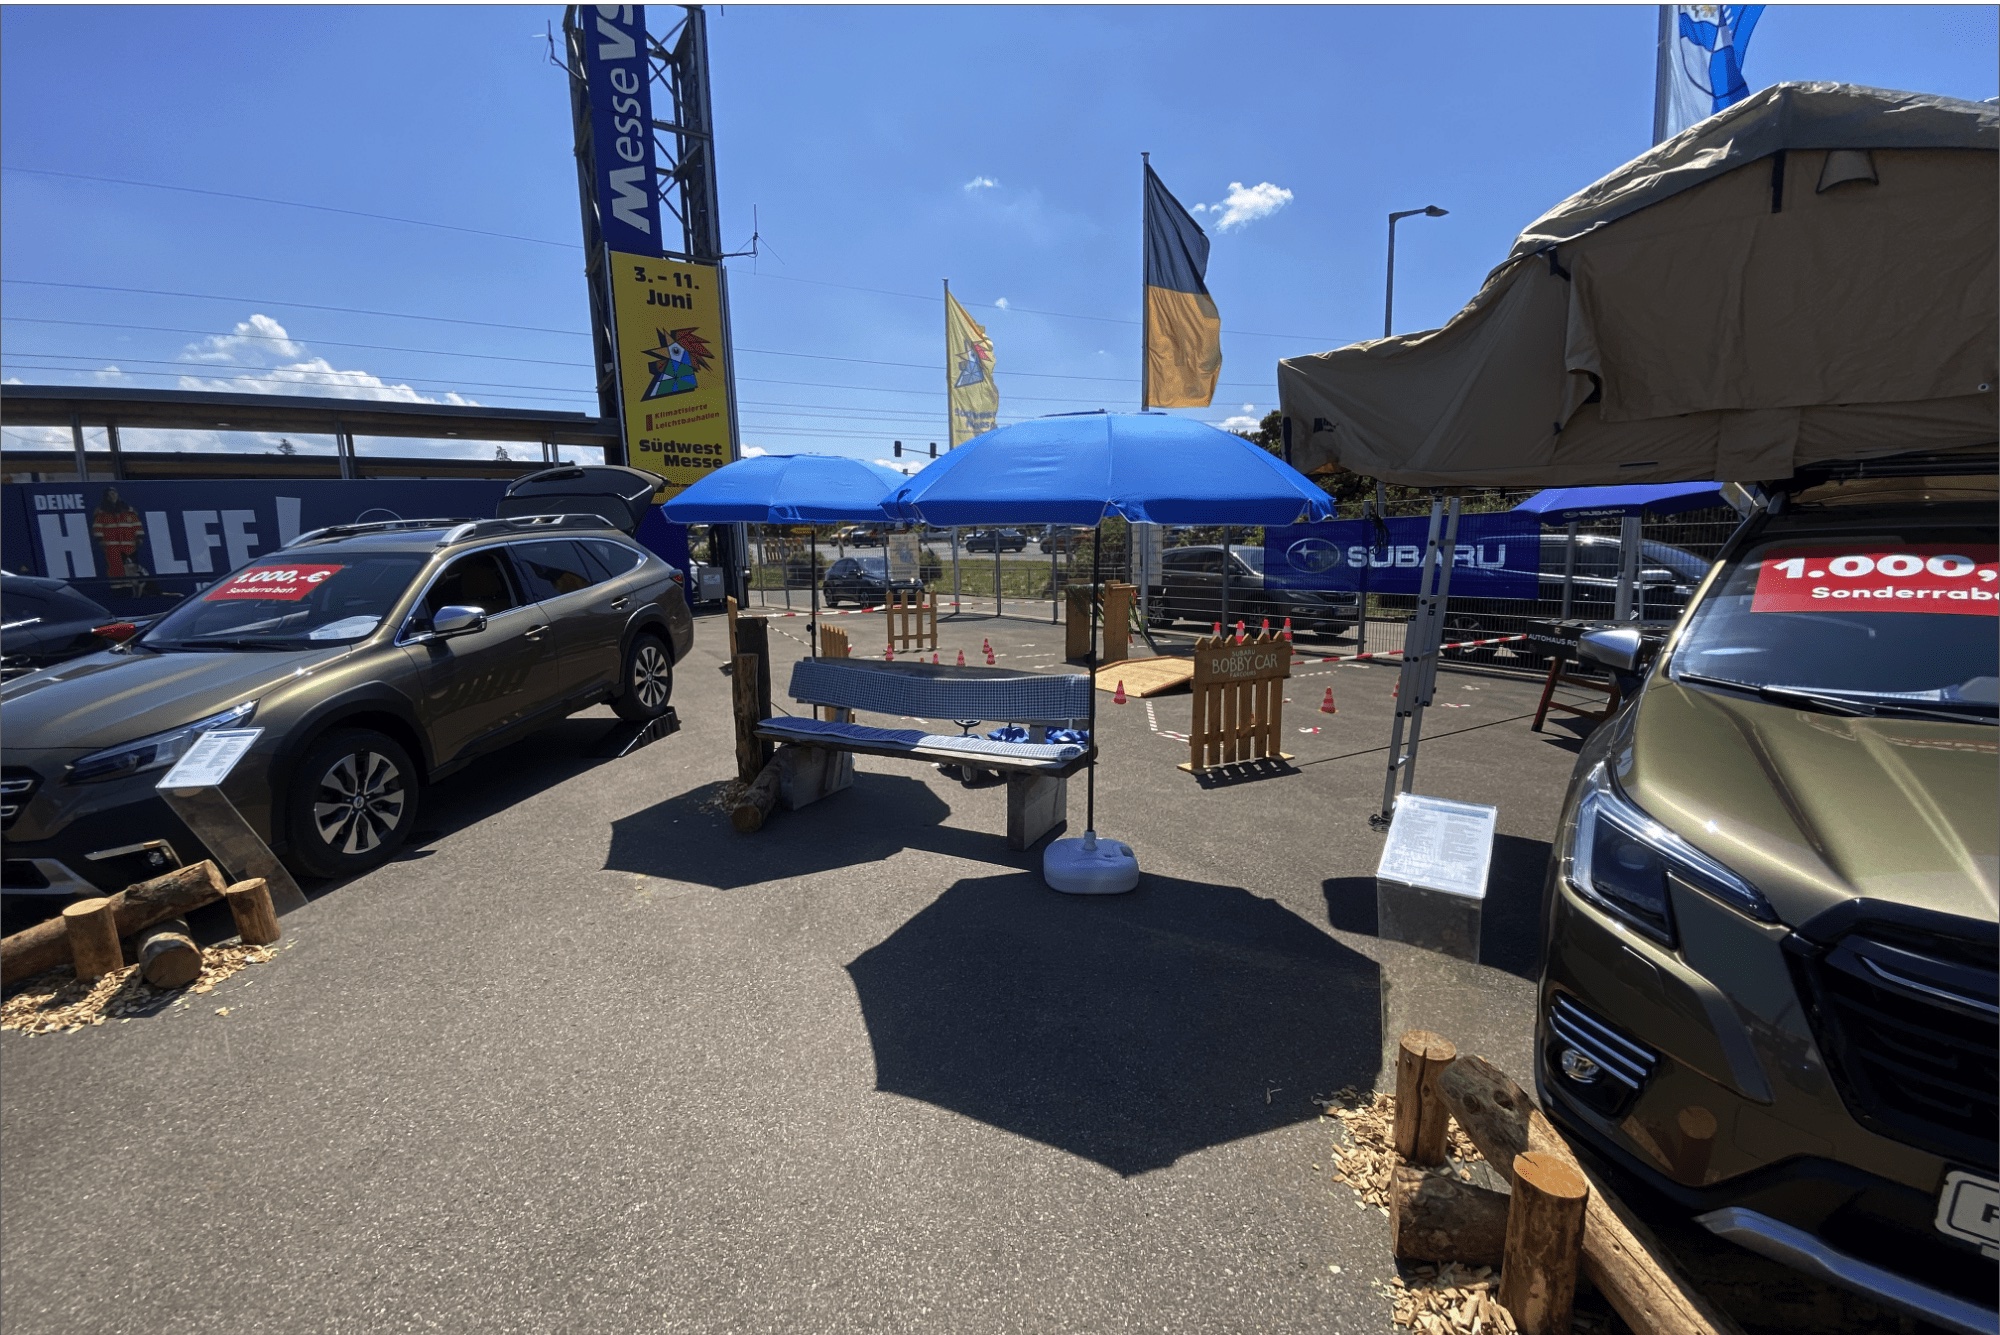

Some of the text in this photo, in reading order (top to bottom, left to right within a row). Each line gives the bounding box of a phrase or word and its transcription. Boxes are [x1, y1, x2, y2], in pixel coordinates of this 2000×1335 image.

[609, 67, 651, 235] Messe
[673, 272, 699, 290] 11.
[646, 288, 693, 310] Juni
[654, 403, 708, 419] Klimatisierte
[639, 438, 722, 455] Südwest
[664, 454, 723, 468] Messe
[34, 494, 86, 510] DEINE
[1811, 585, 1999, 599] Sonderrab
[1528, 633, 1566, 645] AUTOHAUS
[1212, 653, 1278, 674] BOBBY CAR
